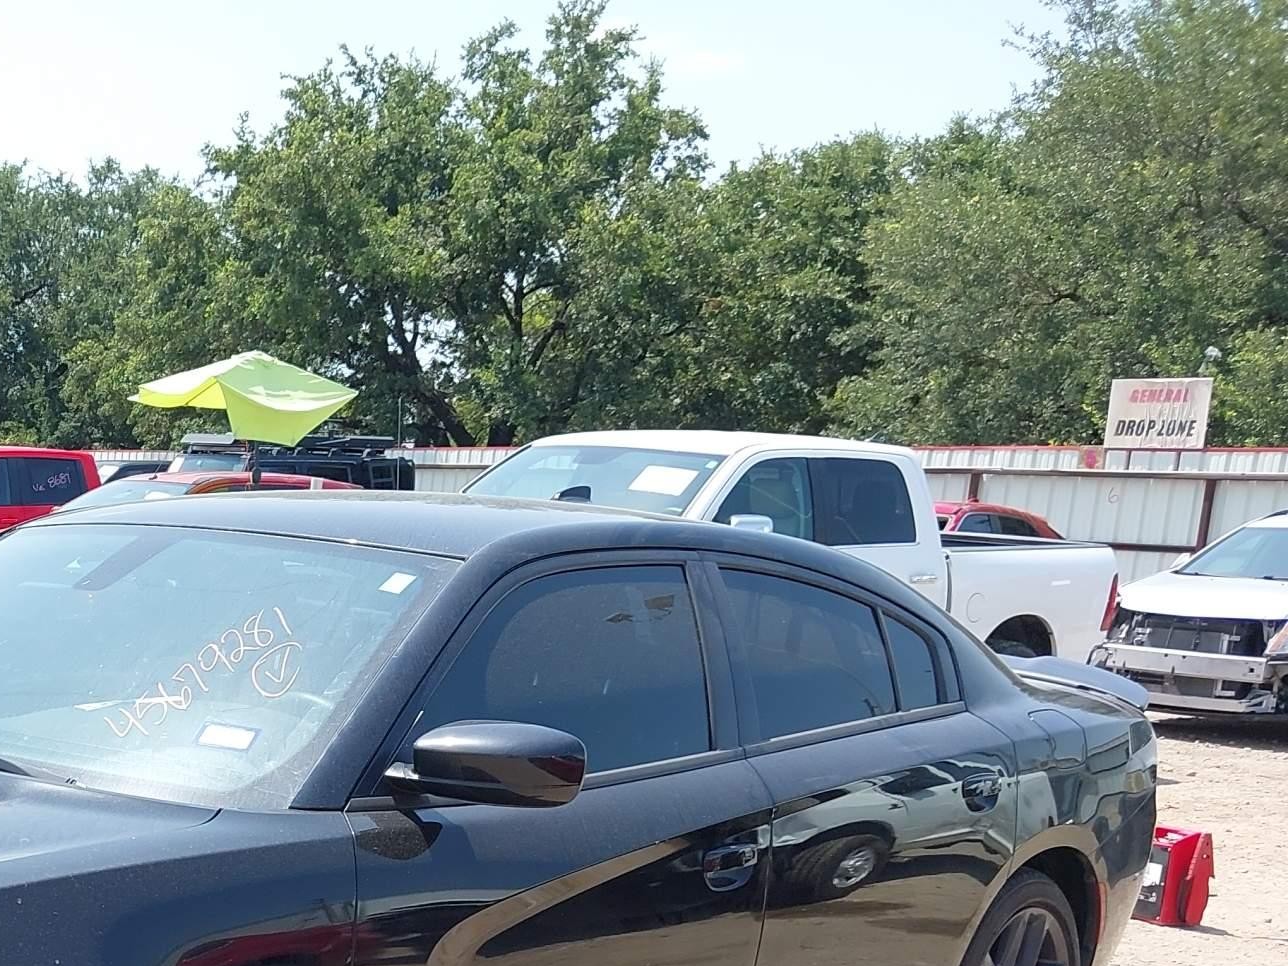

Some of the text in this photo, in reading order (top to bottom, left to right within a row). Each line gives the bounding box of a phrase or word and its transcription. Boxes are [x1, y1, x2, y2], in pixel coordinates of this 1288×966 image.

[1128, 388, 1189, 403] GENERAL
[1114, 420, 1197, 437] DROP ZONE
[103, 606, 292, 737] 45679281
